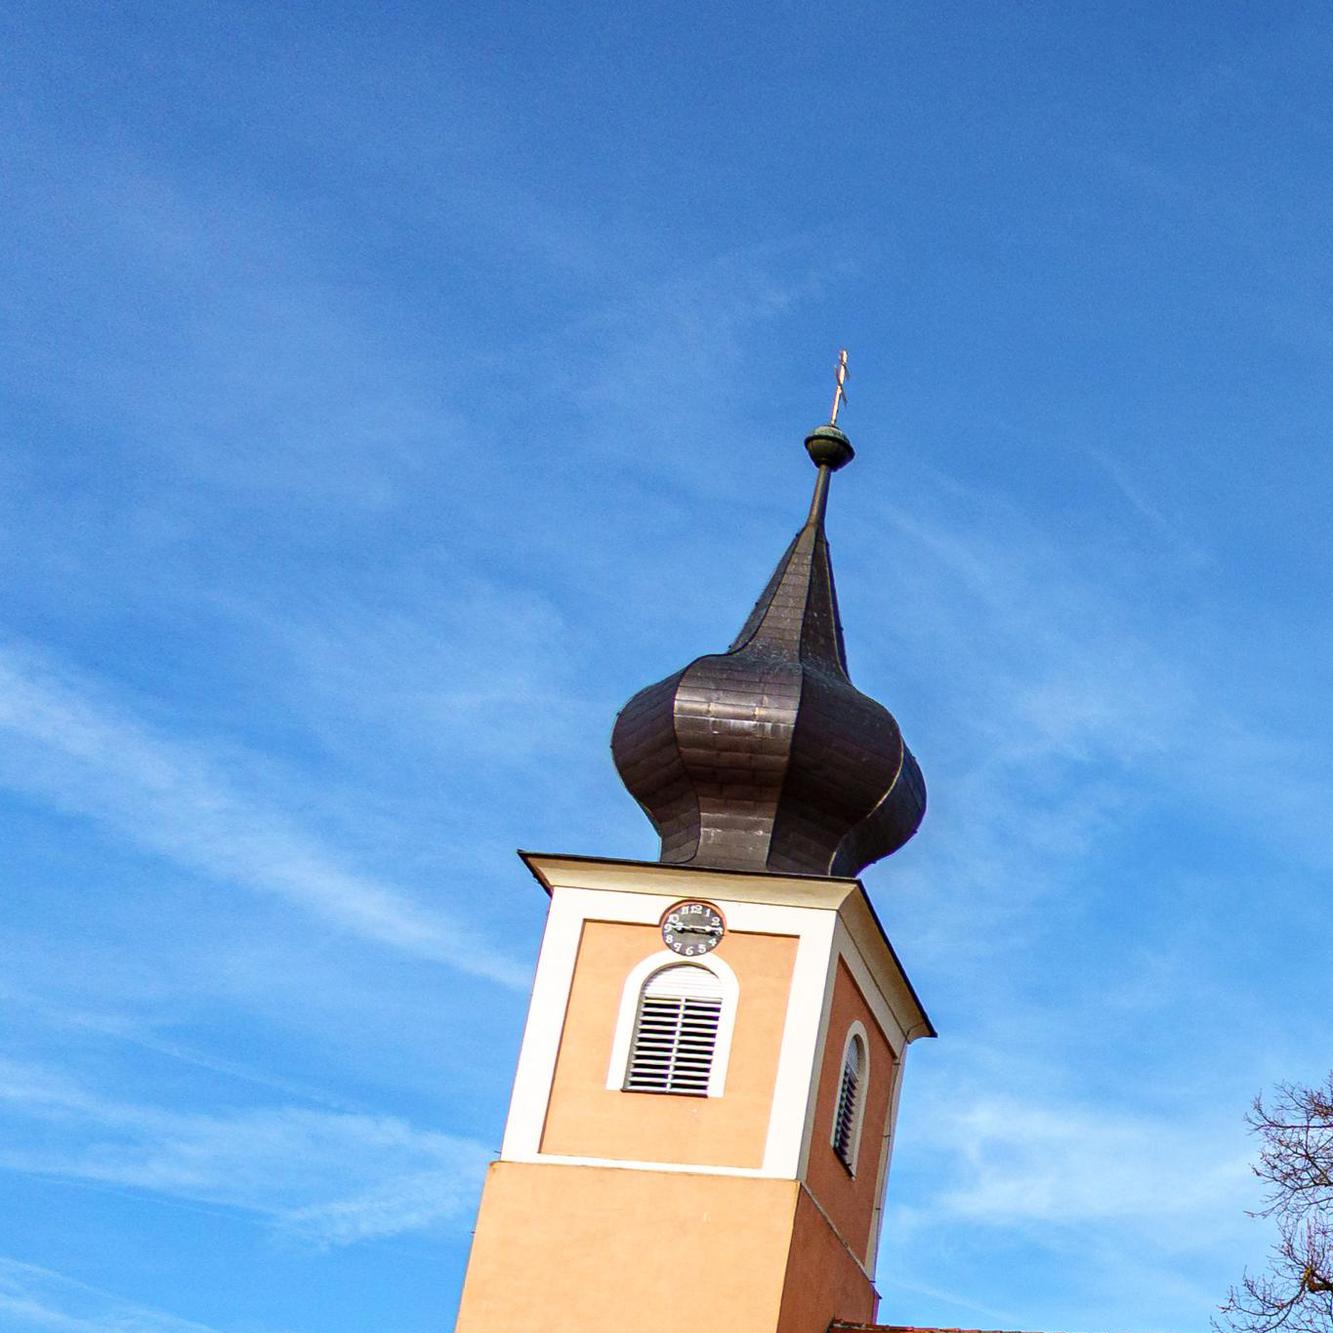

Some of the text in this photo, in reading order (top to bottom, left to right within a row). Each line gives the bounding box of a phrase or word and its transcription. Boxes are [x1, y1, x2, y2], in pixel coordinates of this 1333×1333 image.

[690, 904, 703, 914] 12
[705, 908, 711, 918] 1
[667, 914, 680, 924] 10
[711, 916, 720, 926] 2
[664, 923, 673, 933] 9
[665, 934, 673, 944] 8
[708, 938, 717, 947] 4
[686, 946, 694, 956] 6
[698, 943, 707, 954] 5
